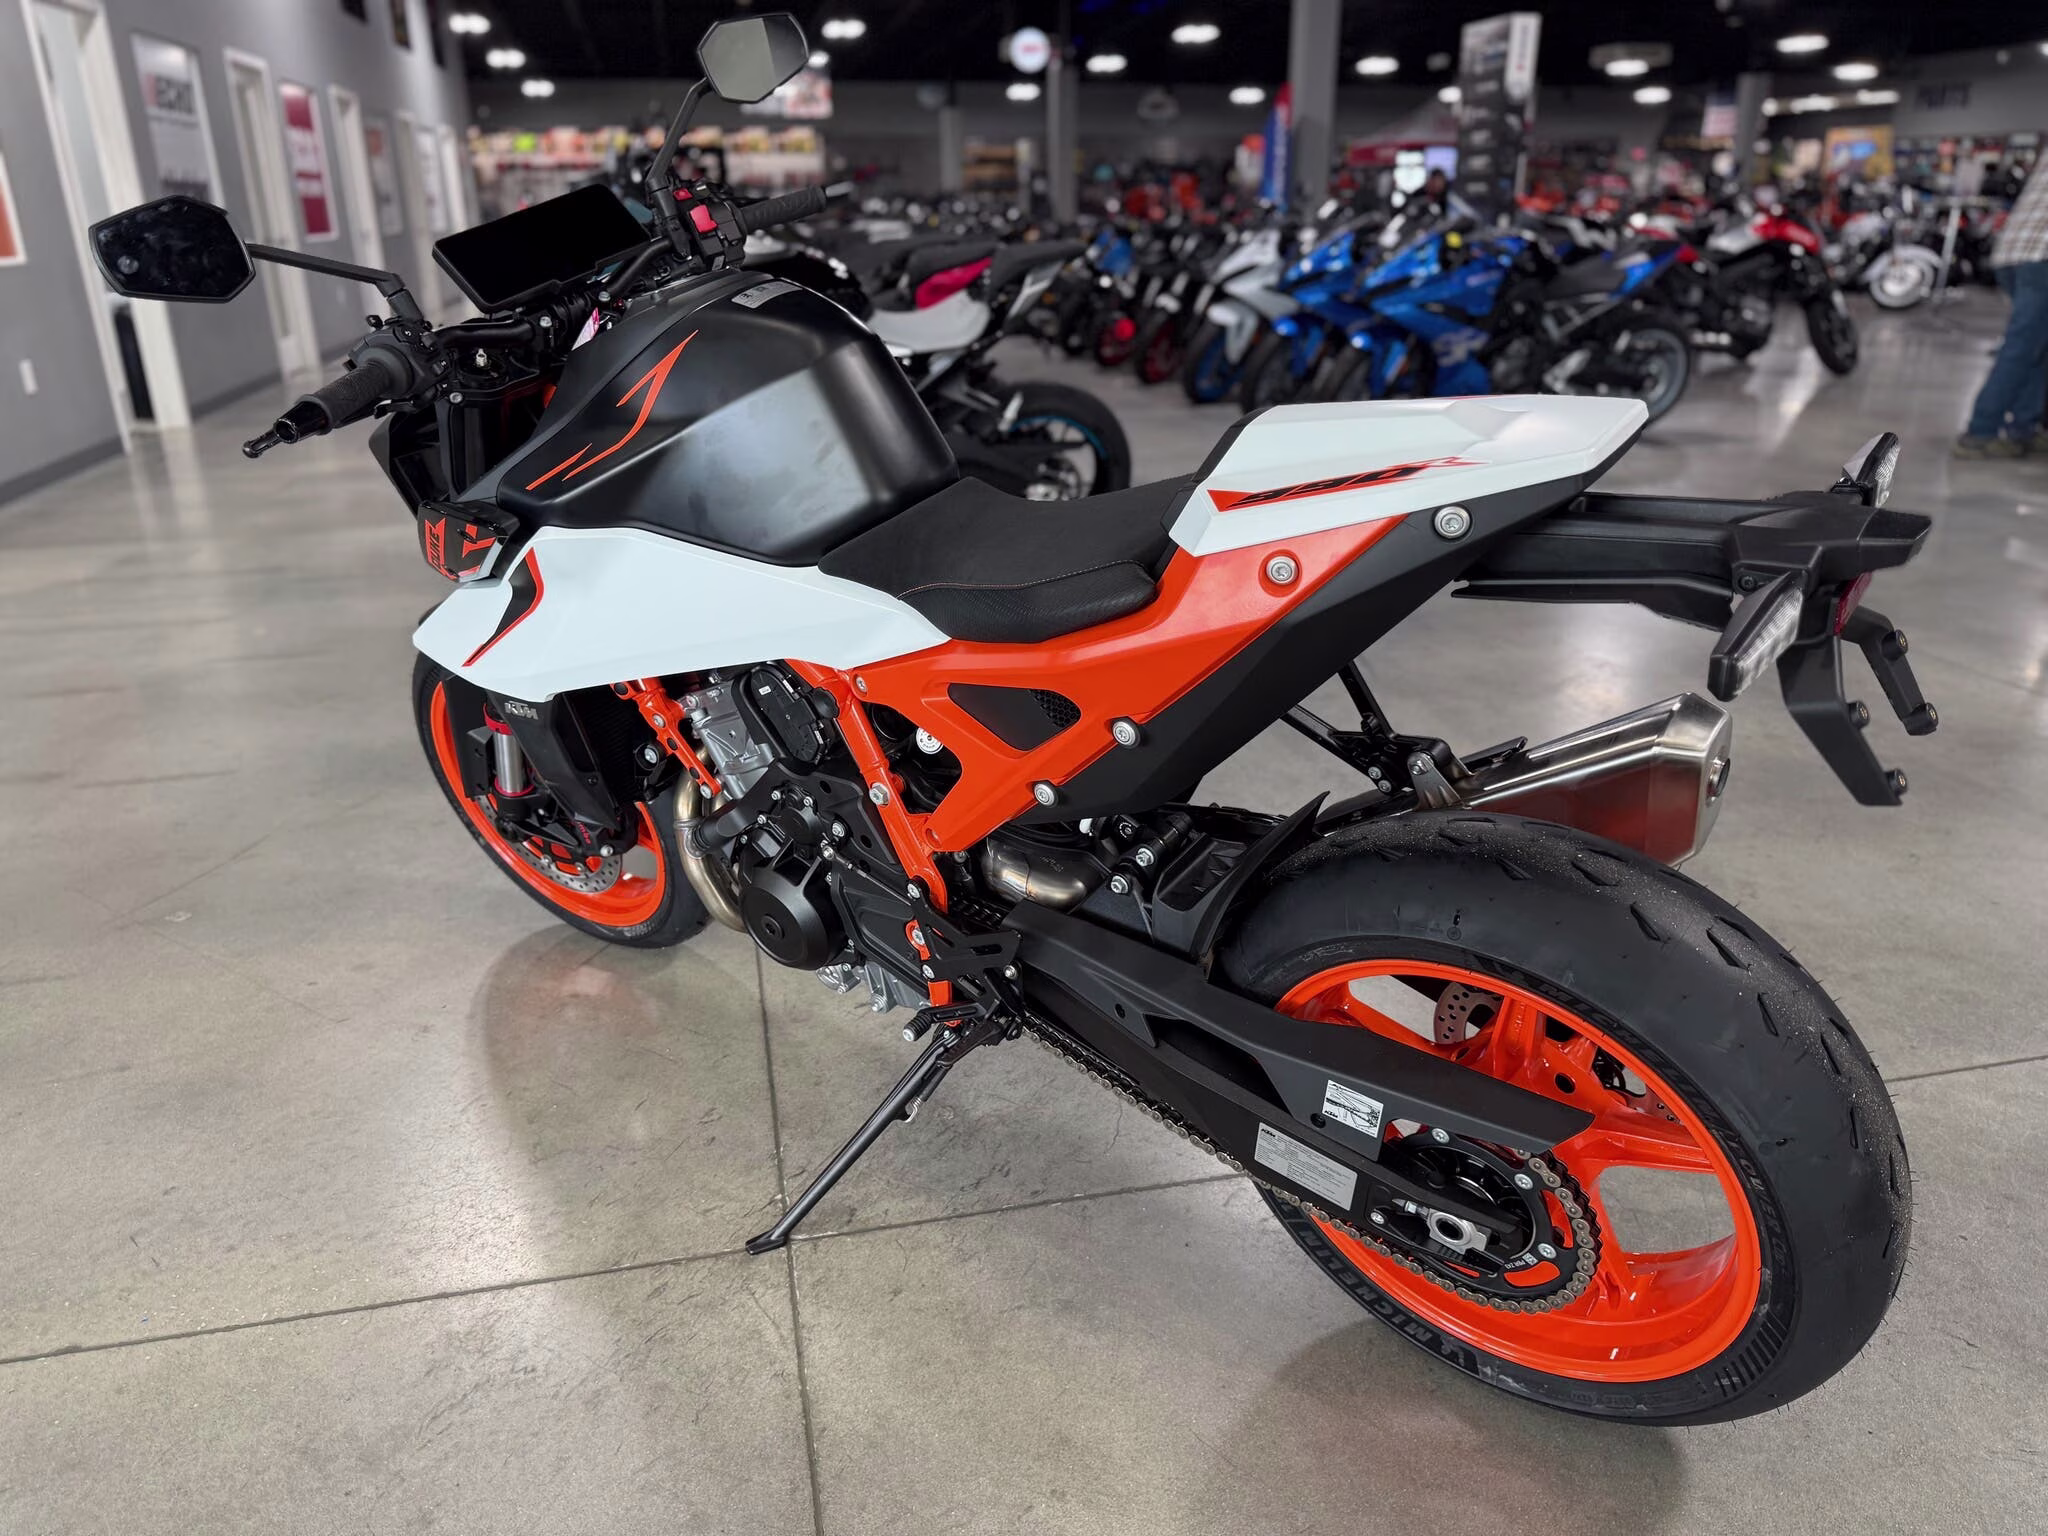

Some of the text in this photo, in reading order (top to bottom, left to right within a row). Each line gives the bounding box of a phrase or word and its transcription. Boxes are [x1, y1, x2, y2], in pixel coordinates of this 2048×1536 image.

[1224, 465, 1431, 509] 990
[504, 700, 539, 720] KTM
[1324, 1109, 1339, 1119] KTM
[1260, 1127, 1277, 1138] KTM
[1300, 1228, 1433, 1343] MICHELIN
